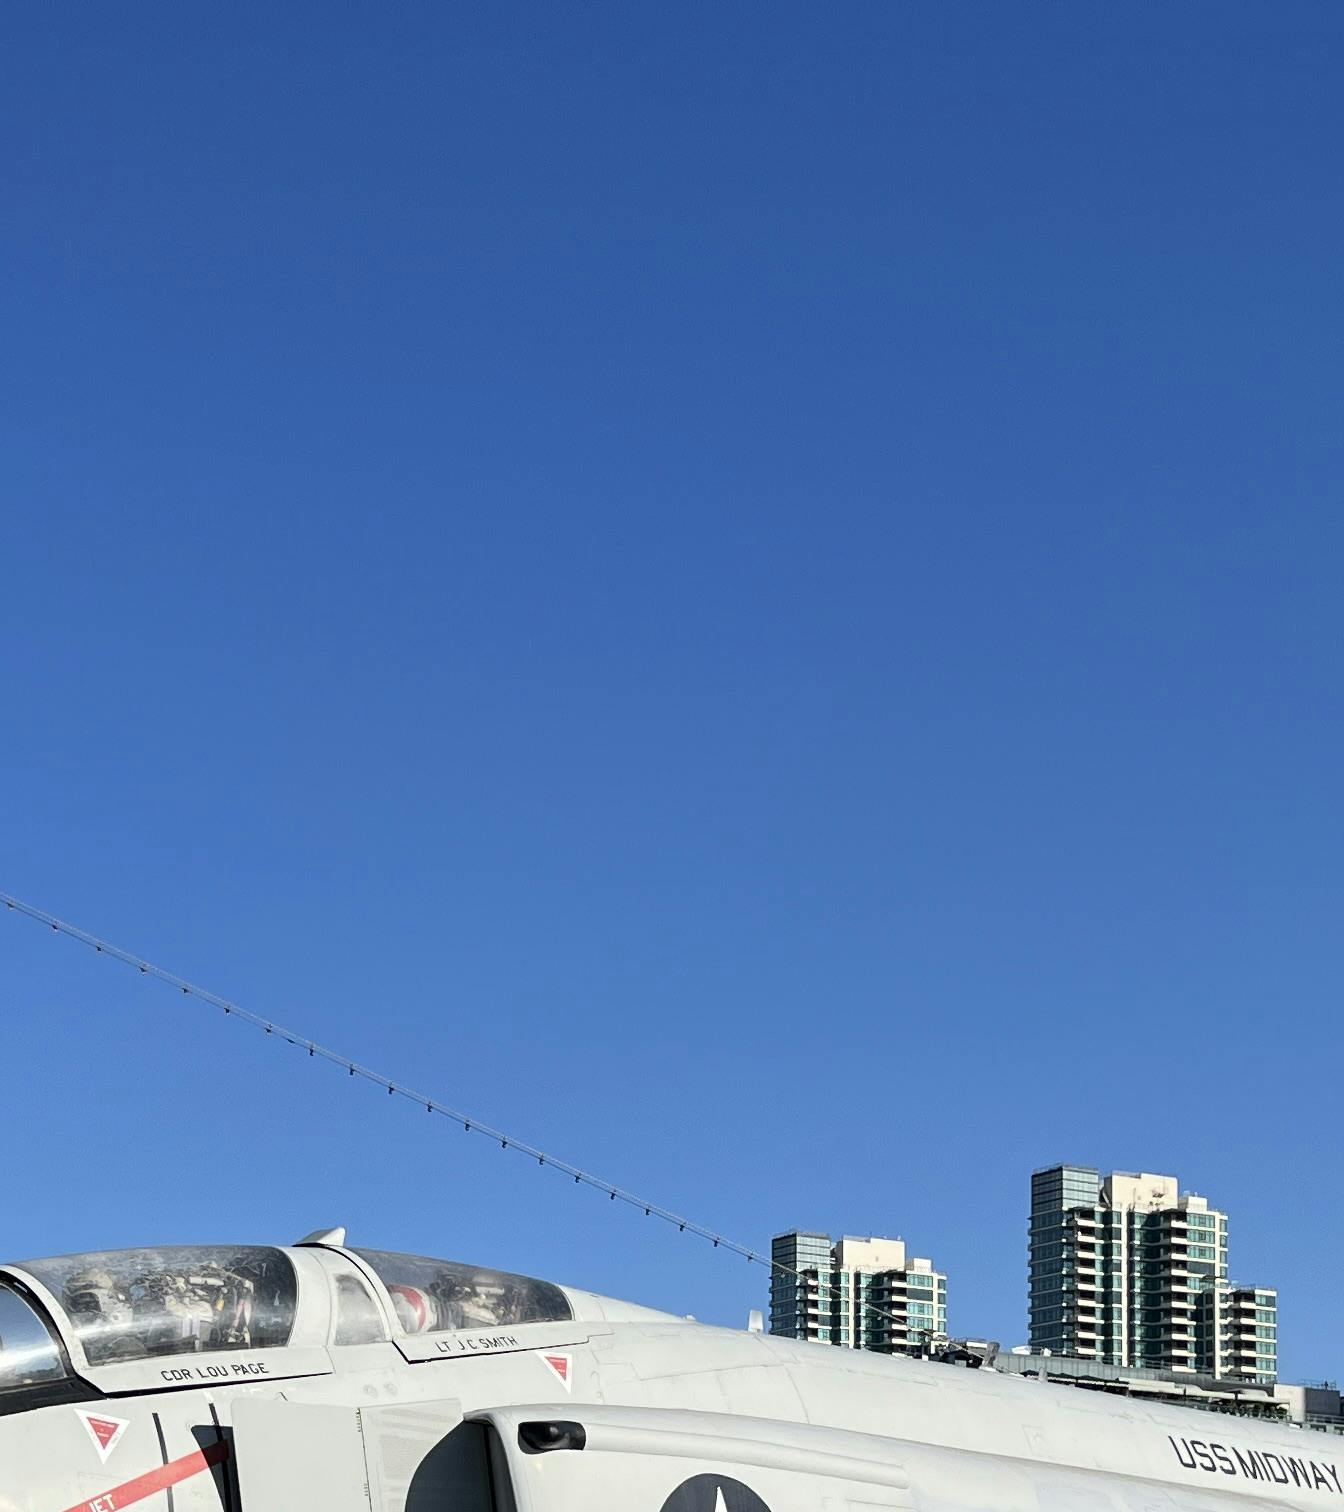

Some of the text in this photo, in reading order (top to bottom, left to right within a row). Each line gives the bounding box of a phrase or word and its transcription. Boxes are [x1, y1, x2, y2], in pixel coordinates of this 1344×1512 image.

[435, 1341, 452, 1353] LT
[479, 1336, 519, 1349] SMITH
[160, 1363, 269, 1381] CDR LOU PAGE
[1168, 1435, 1343, 1493] USS MIDWAY
